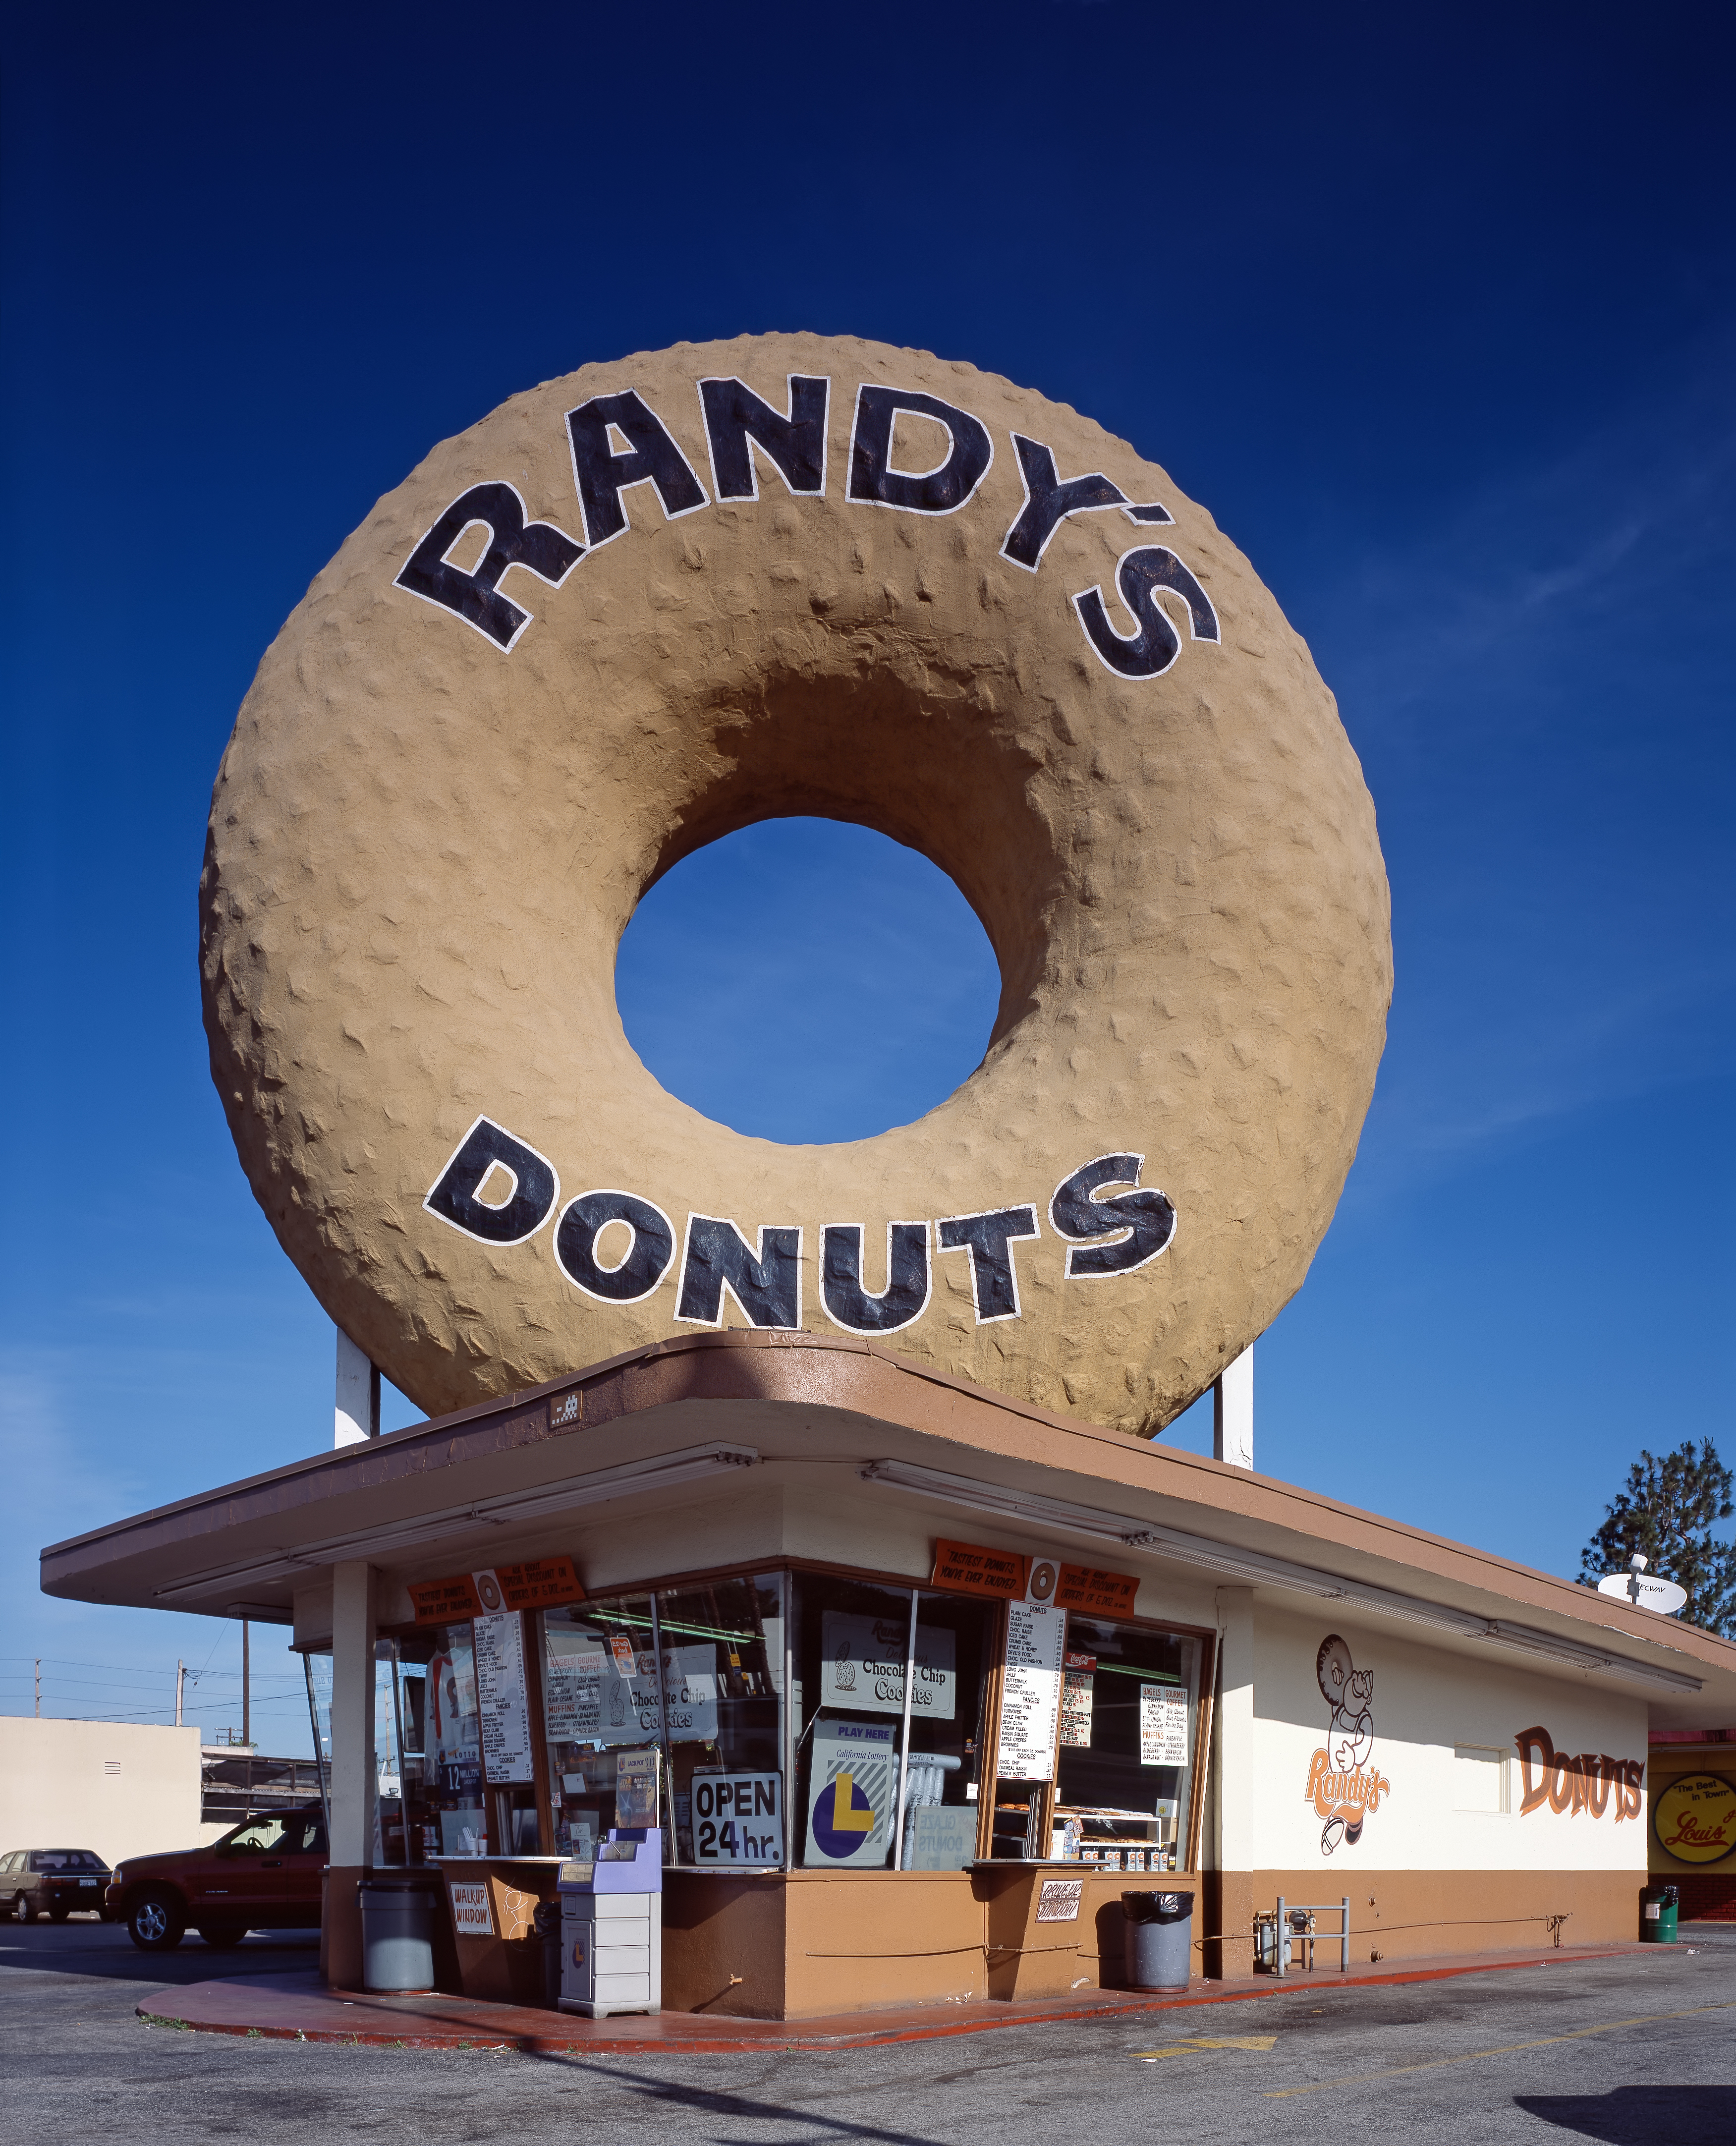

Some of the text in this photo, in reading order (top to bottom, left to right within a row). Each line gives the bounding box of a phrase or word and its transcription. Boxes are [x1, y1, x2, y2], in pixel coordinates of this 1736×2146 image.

[394, 369, 1221, 681] RANDY'S
[421, 1115, 1179, 1339] DONUTS
[984, 1557, 1014, 1574] DONUTS
[1080, 1568, 1091, 1577] ASK
[526, 1569, 555, 1583] DISCOUNT
[559, 1566, 566, 1578] ON
[941, 1565, 963, 1581] YOU'VE
[966, 1570, 983, 1584] EVER
[443, 1585, 466, 1598] DONUTS
[508, 1588, 529, 1602] ORDERS
[531, 1586, 538, 1597] OF
[542, 1585, 548, 1595] 5
[1089, 1578, 1120, 1594] DISCOUNT
[1120, 1585, 1131, 1596] ON
[1640, 1584, 1666, 1593] ECWAY
[1061, 1588, 1084, 1602] ORDERS
[1086, 1593, 1095, 1603] OF
[1096, 1595, 1102, 1604] 5
[419, 1605, 434, 1617] YOU'VE
[437, 1603, 448, 1614] EVER
[550, 1658, 574, 1667] BAGELS
[885, 1646, 928, 1663] Delous
[579, 1664, 600, 1674] COFFEE
[863, 1659, 946, 1686] Chocolae Chip
[681, 1687, 706, 1705] Chip
[875, 1678, 932, 1705] Cooies
[1143, 1687, 1161, 1696] BAGELS
[1166, 1690, 1186, 1699] GOURMET
[548, 1704, 575, 1714] MUFFINS
[838, 1726, 890, 1740] PLAY HERE
[1143, 1731, 1164, 1740] MUFFINS
[836, 1749, 888, 1762] California Lottery
[448, 1766, 460, 1790] 12
[460, 1769, 479, 1778] MILLION
[1514, 1725, 1647, 1824] DONUTS
[1304, 1747, 1391, 1825] Randy's
[1696, 1780, 1717, 1790] Best
[696, 1779, 776, 1817] OPEN
[1665, 1810, 1730, 1847] Louis
[698, 1820, 780, 1861] 24 hr.
[457, 1909, 487, 1924] WINDOW
